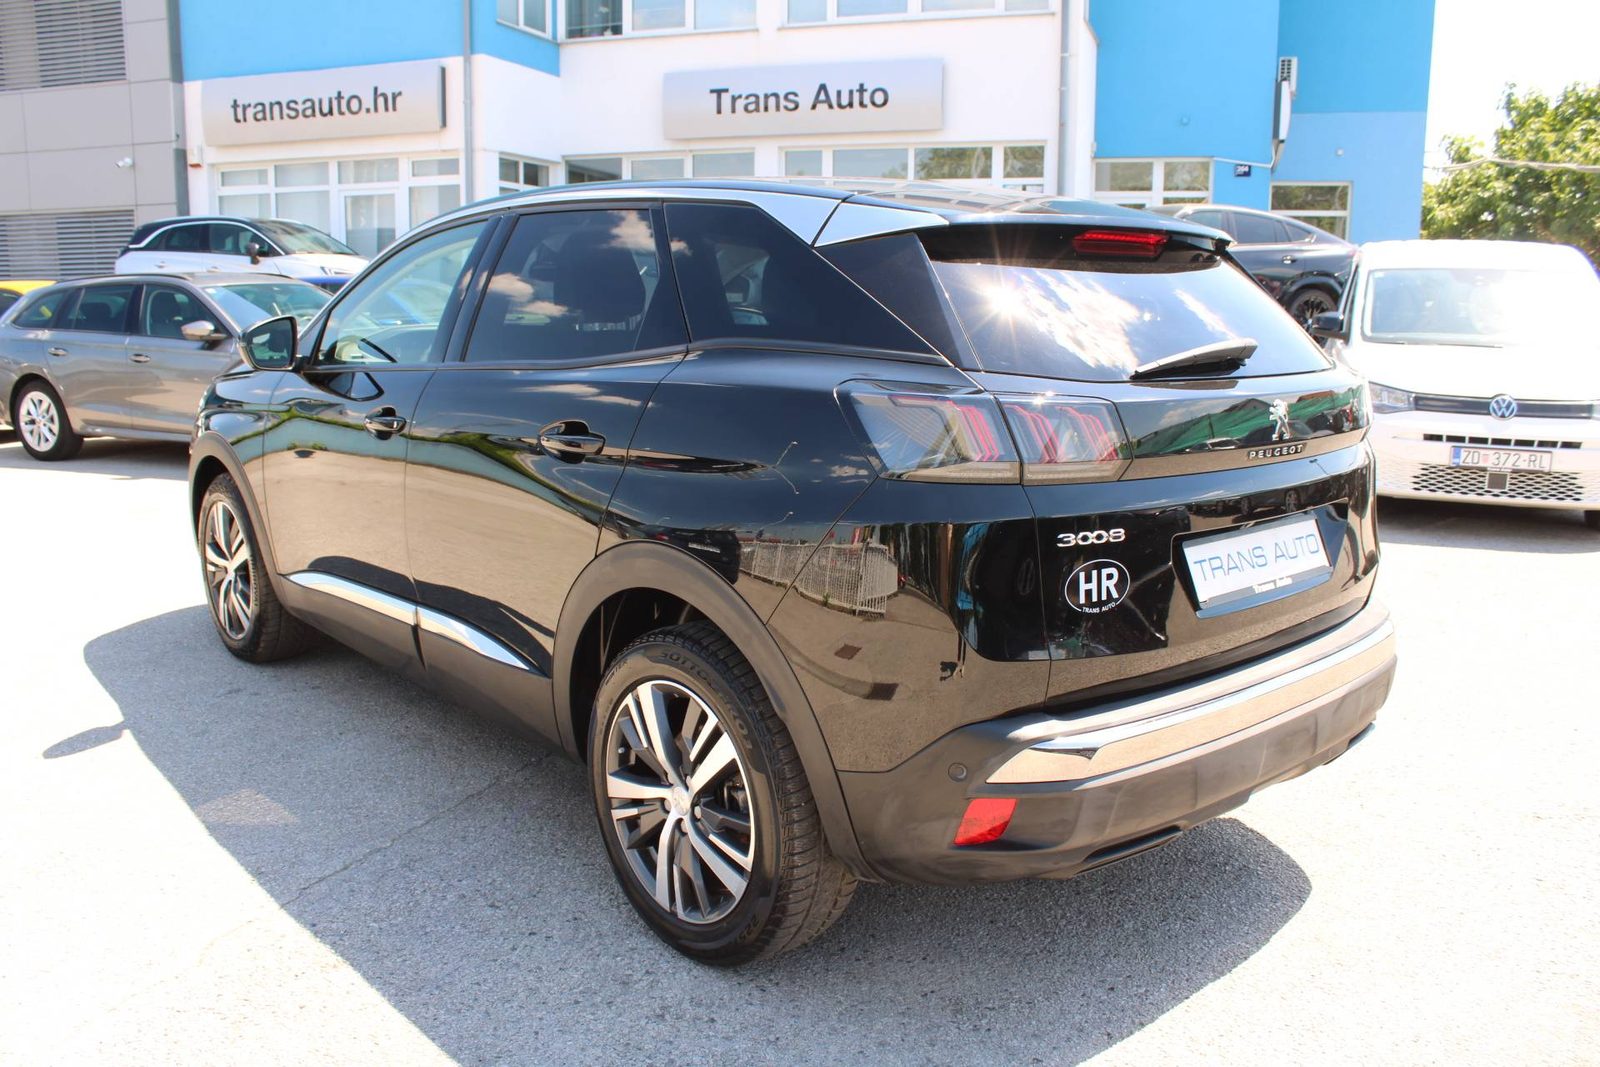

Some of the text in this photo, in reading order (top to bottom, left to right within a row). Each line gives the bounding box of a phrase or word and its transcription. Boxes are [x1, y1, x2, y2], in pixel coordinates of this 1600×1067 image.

[231, 86, 402, 123] transauto.hr
[709, 82, 889, 115] Trans Auto
[1249, 444, 1303, 459] PEUGEOT
[1462, 450, 1480, 465] ZD
[1492, 451, 1547, 469] 372-RL
[1056, 529, 1125, 547] 3008
[1193, 534, 1319, 581] TRANS AUTO
[1079, 567, 1119, 604] HR
[1101, 601, 1116, 612] AUTO
